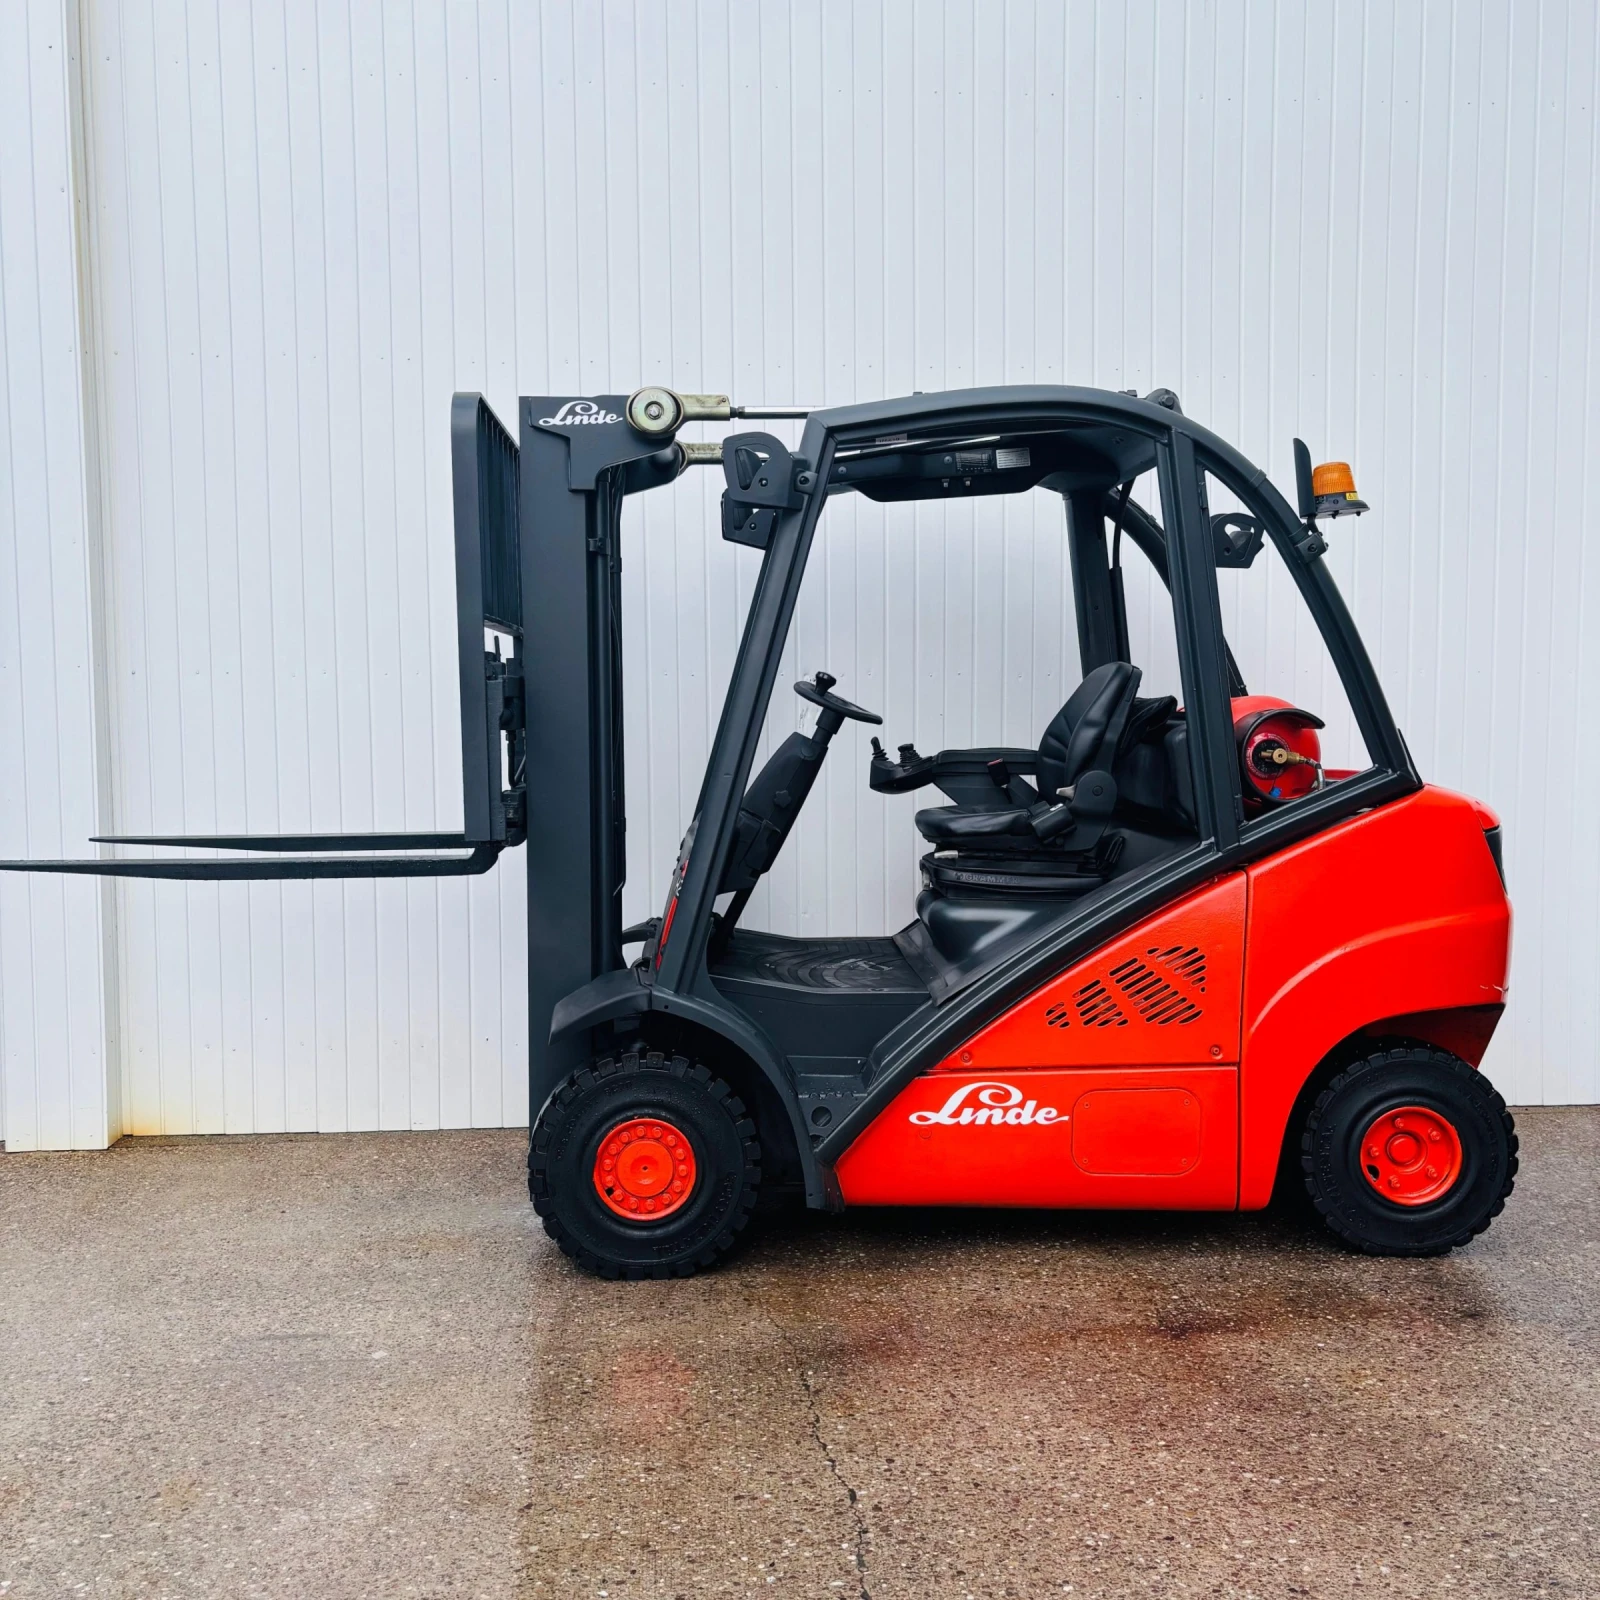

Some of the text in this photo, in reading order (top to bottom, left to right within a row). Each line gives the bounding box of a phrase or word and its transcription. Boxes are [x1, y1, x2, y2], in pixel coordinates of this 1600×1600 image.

[538, 400, 623, 426] Linde
[965, 873, 1019, 884] GRAMMER
[908, 1081, 1069, 1125] Linde
